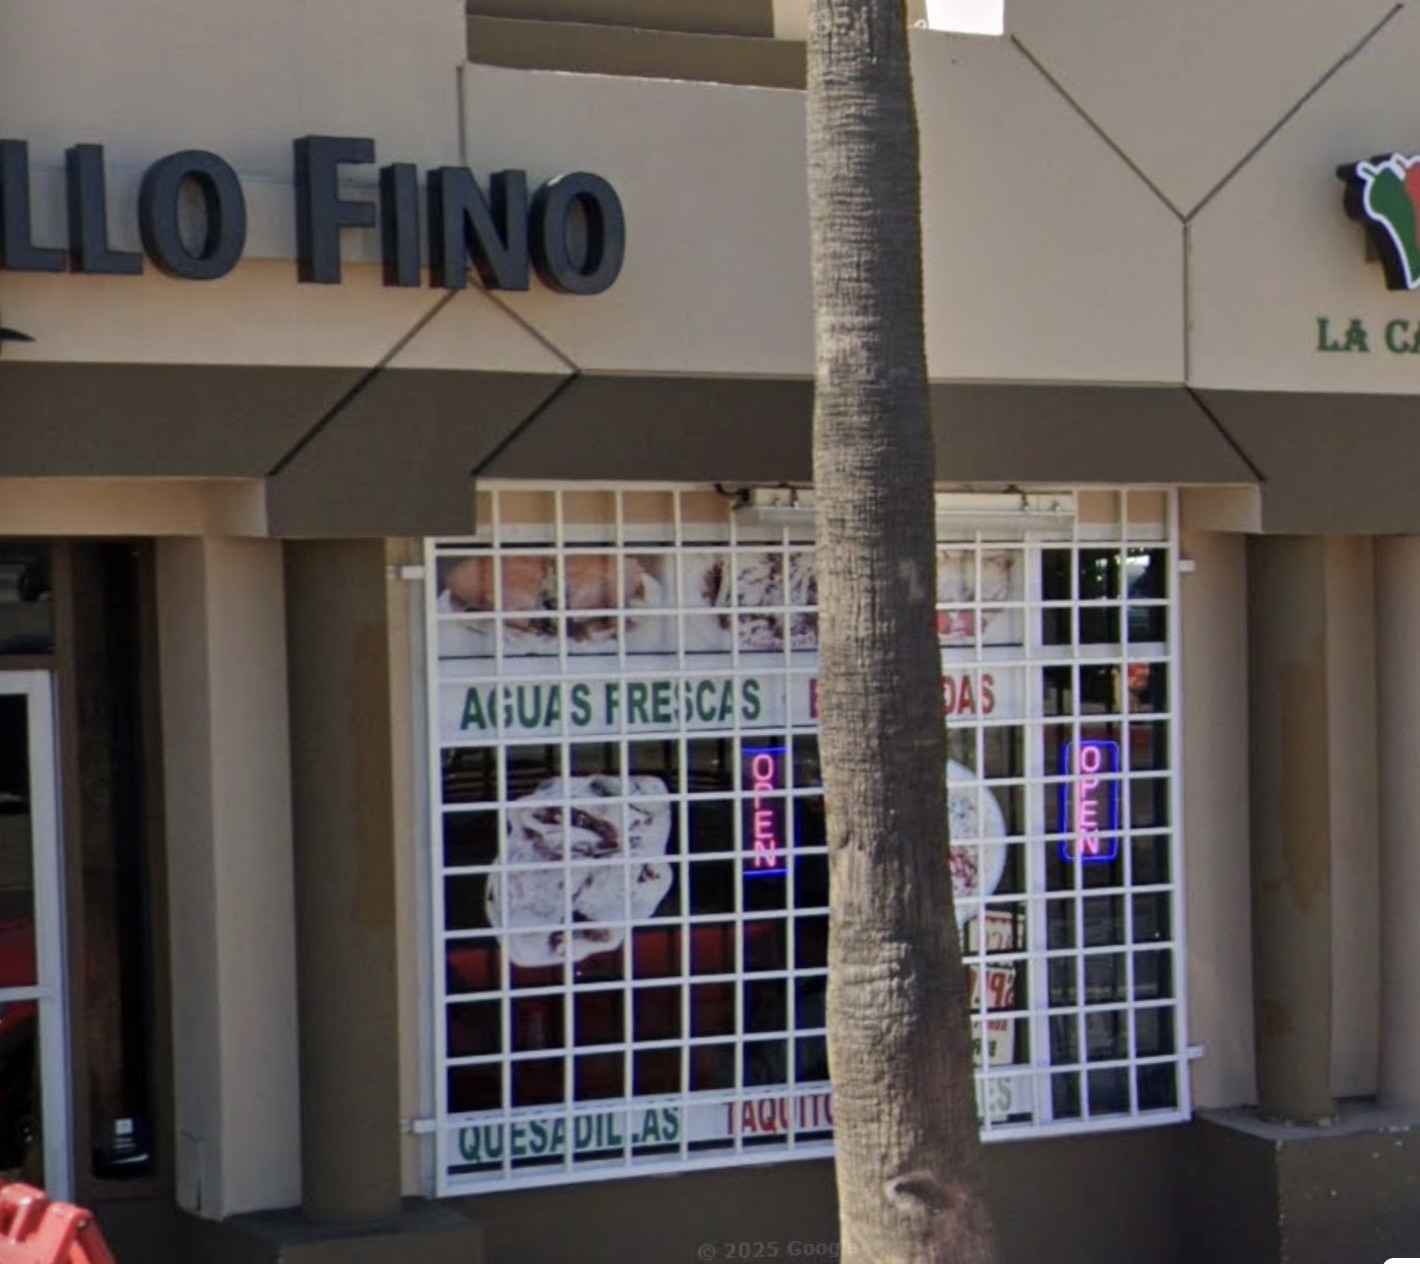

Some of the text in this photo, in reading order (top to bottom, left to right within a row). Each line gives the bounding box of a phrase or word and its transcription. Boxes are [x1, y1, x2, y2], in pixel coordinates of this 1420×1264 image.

[293, 136, 626, 295] FINO
[1316, 318, 1368, 354] LA
[460, 683, 593, 731] AGUAS
[605, 679, 761, 725] FRESCAS
[752, 753, 775, 867] OPEN
[1078, 745, 1101, 854] OPEN
[459, 1106, 679, 1163] QUESADILAS
